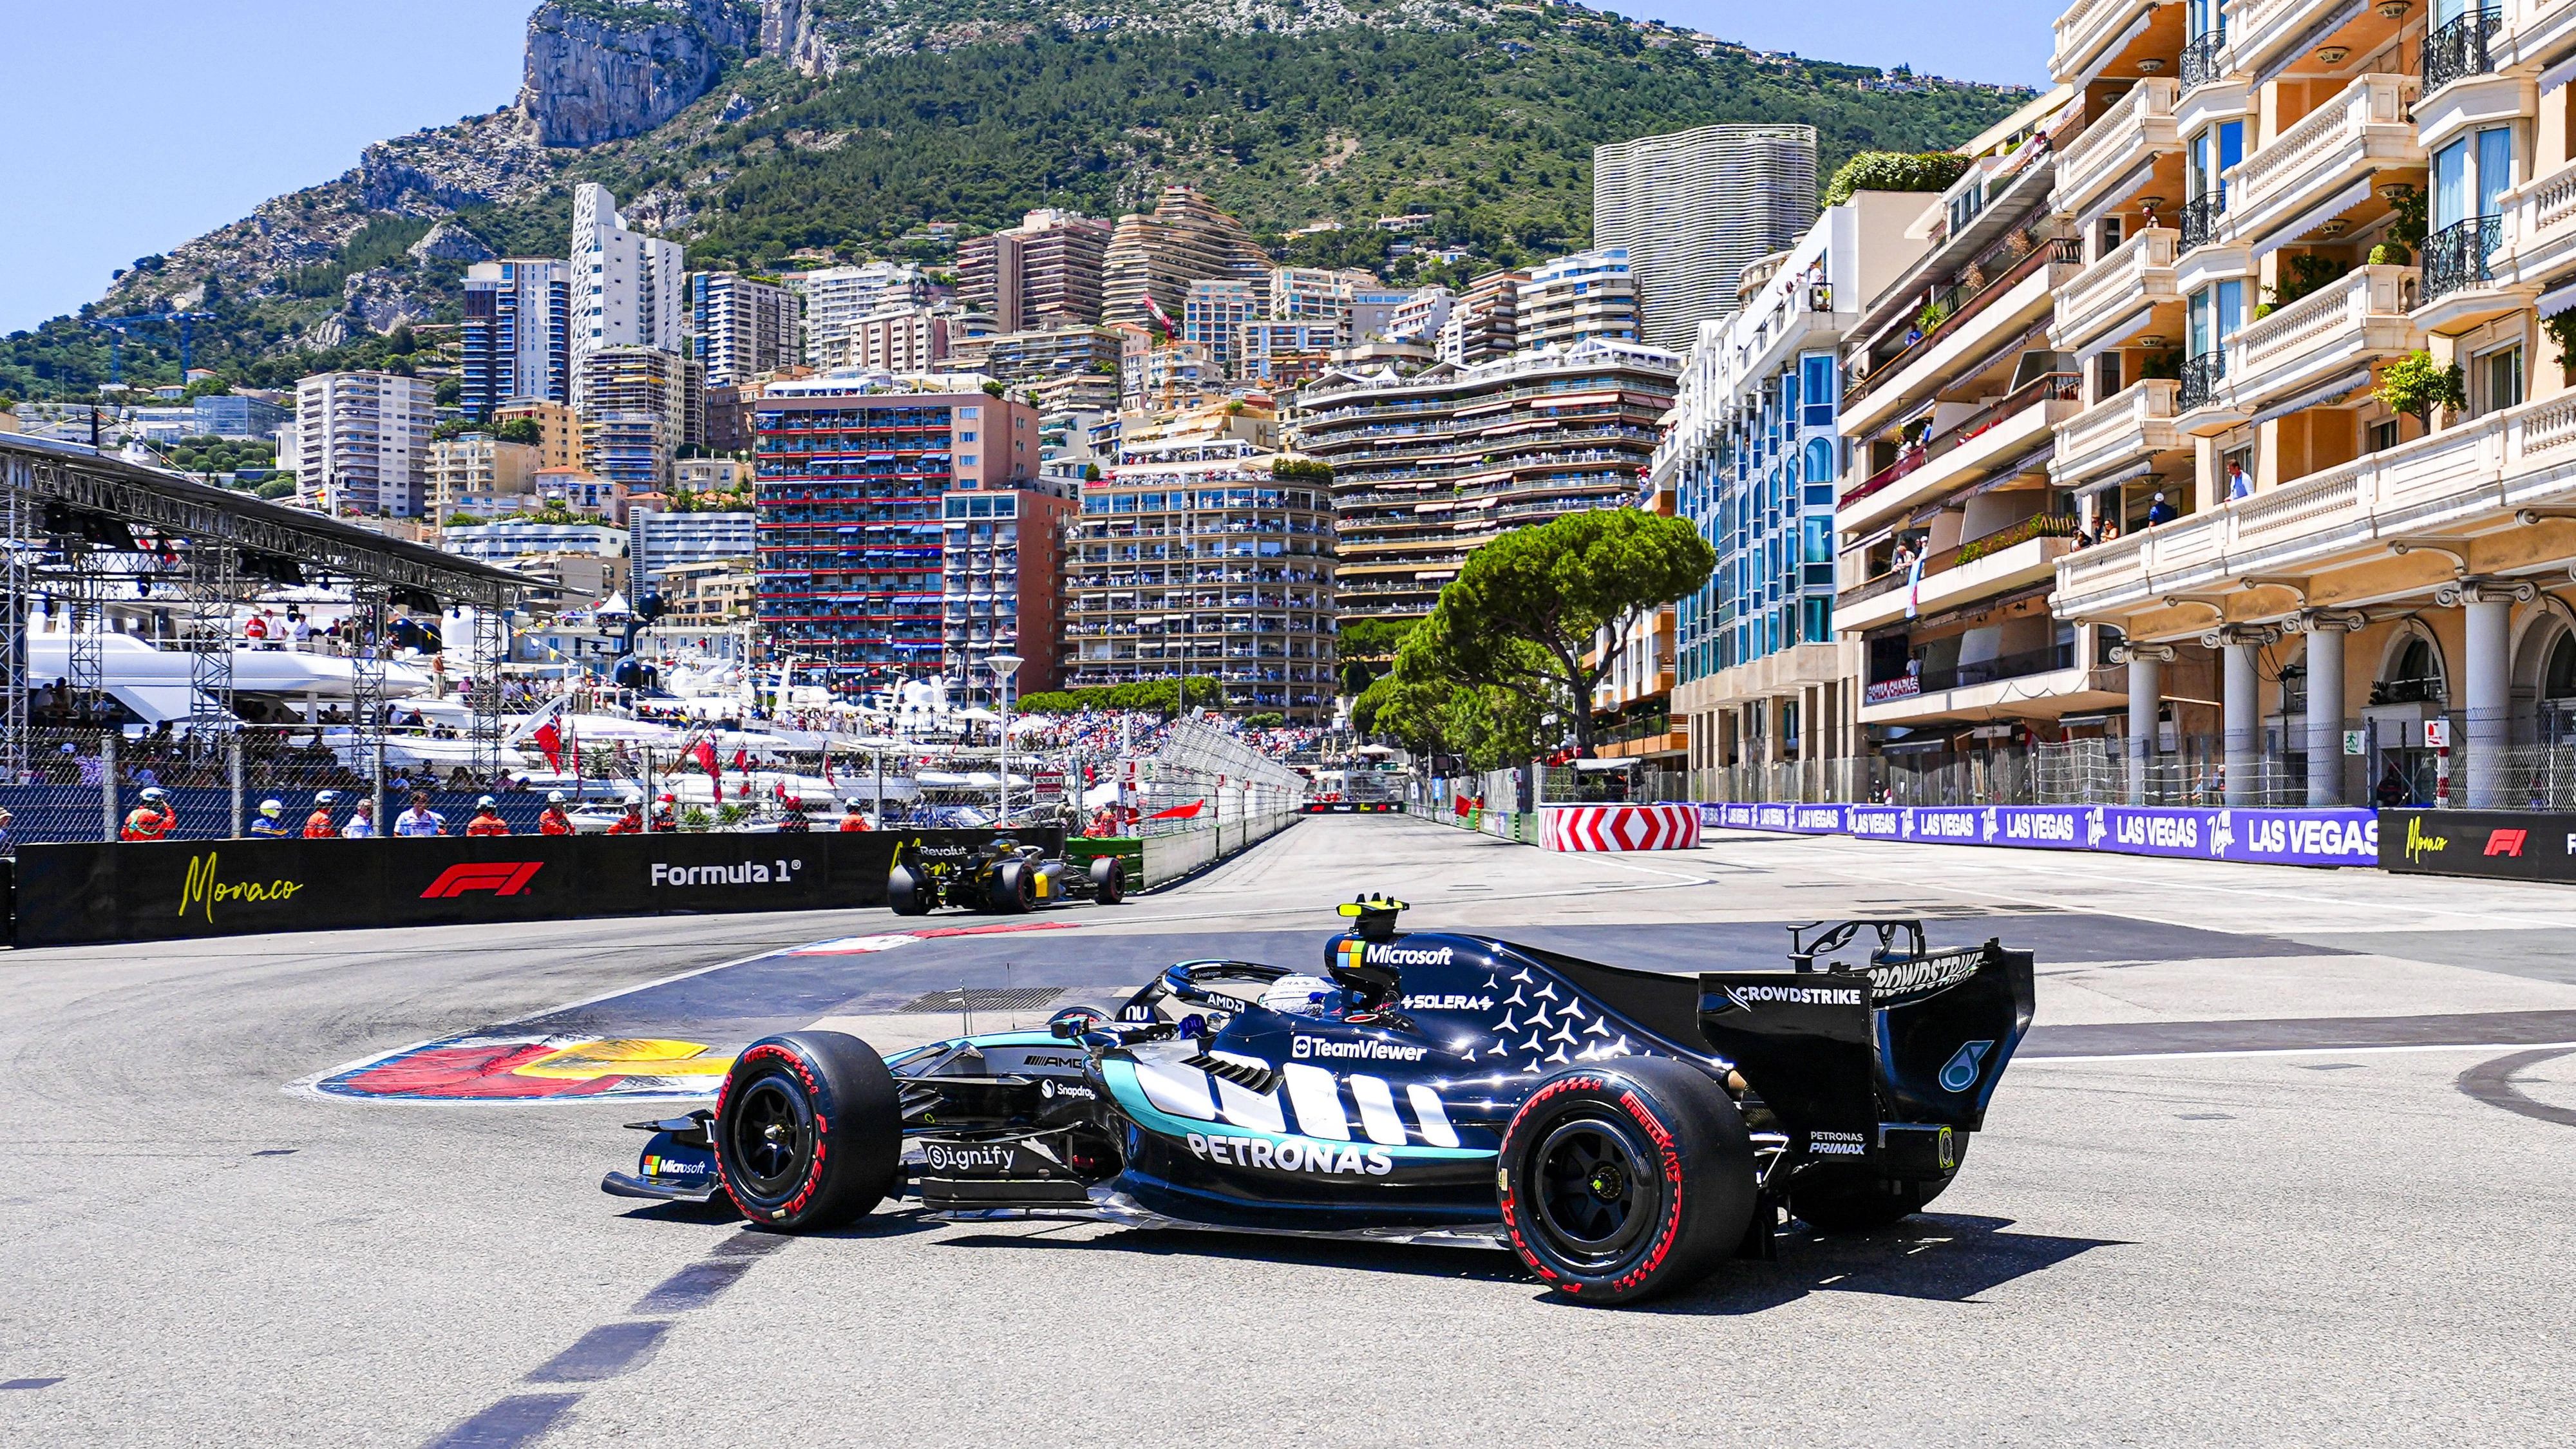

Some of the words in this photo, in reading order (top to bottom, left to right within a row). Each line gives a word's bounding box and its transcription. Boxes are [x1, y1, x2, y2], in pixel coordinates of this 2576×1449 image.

[1811, 810, 1839, 829] VEGAS
[1853, 813, 1868, 833] LAS
[1868, 813, 1897, 834] VEGAS
[1920, 813, 1940, 836] LAS
[1940, 813, 1975, 837] VEGAS
[2006, 813, 2031, 838] LAS
[2031, 814, 2074, 841] VEGAS
[2117, 815, 2146, 846] LAS
[2146, 817, 2197, 848] VEGAS
[2248, 819, 2286, 853] LAS
[2288, 819, 2378, 856] VEGAS
[2405, 816, 2448, 864] Monaco
[920, 845, 968, 857] Revolut
[651, 860, 770, 886] Formula
[178, 851, 304, 924] Monaco
[1366, 944, 1454, 965] Microsoft
[1207, 994, 1235, 1010] AMD
[1412, 995, 1479, 1010] SOLERA
[1736, 986, 1861, 1005] CROWDSTRIKE
[1312, 1037, 1428, 1062] TeamViewer
[1043, 1056, 1083, 1069] AMG
[1057, 1083, 1096, 1101] Snapdrag
[815, 1113, 828, 1133] P
[1619, 1090, 1671, 1145] PIRELLI
[1810, 1131, 1864, 1142] PETRONAS
[1186, 1133, 1394, 1176] PETRONAS
[1809, 1142, 1867, 1155] PRIMAX
[659, 1159, 706, 1174] Microsoft
[793, 1139, 827, 1213] ZERO
[1501, 1200, 1558, 1282] ZERO
[1562, 1282, 1583, 1294] P
